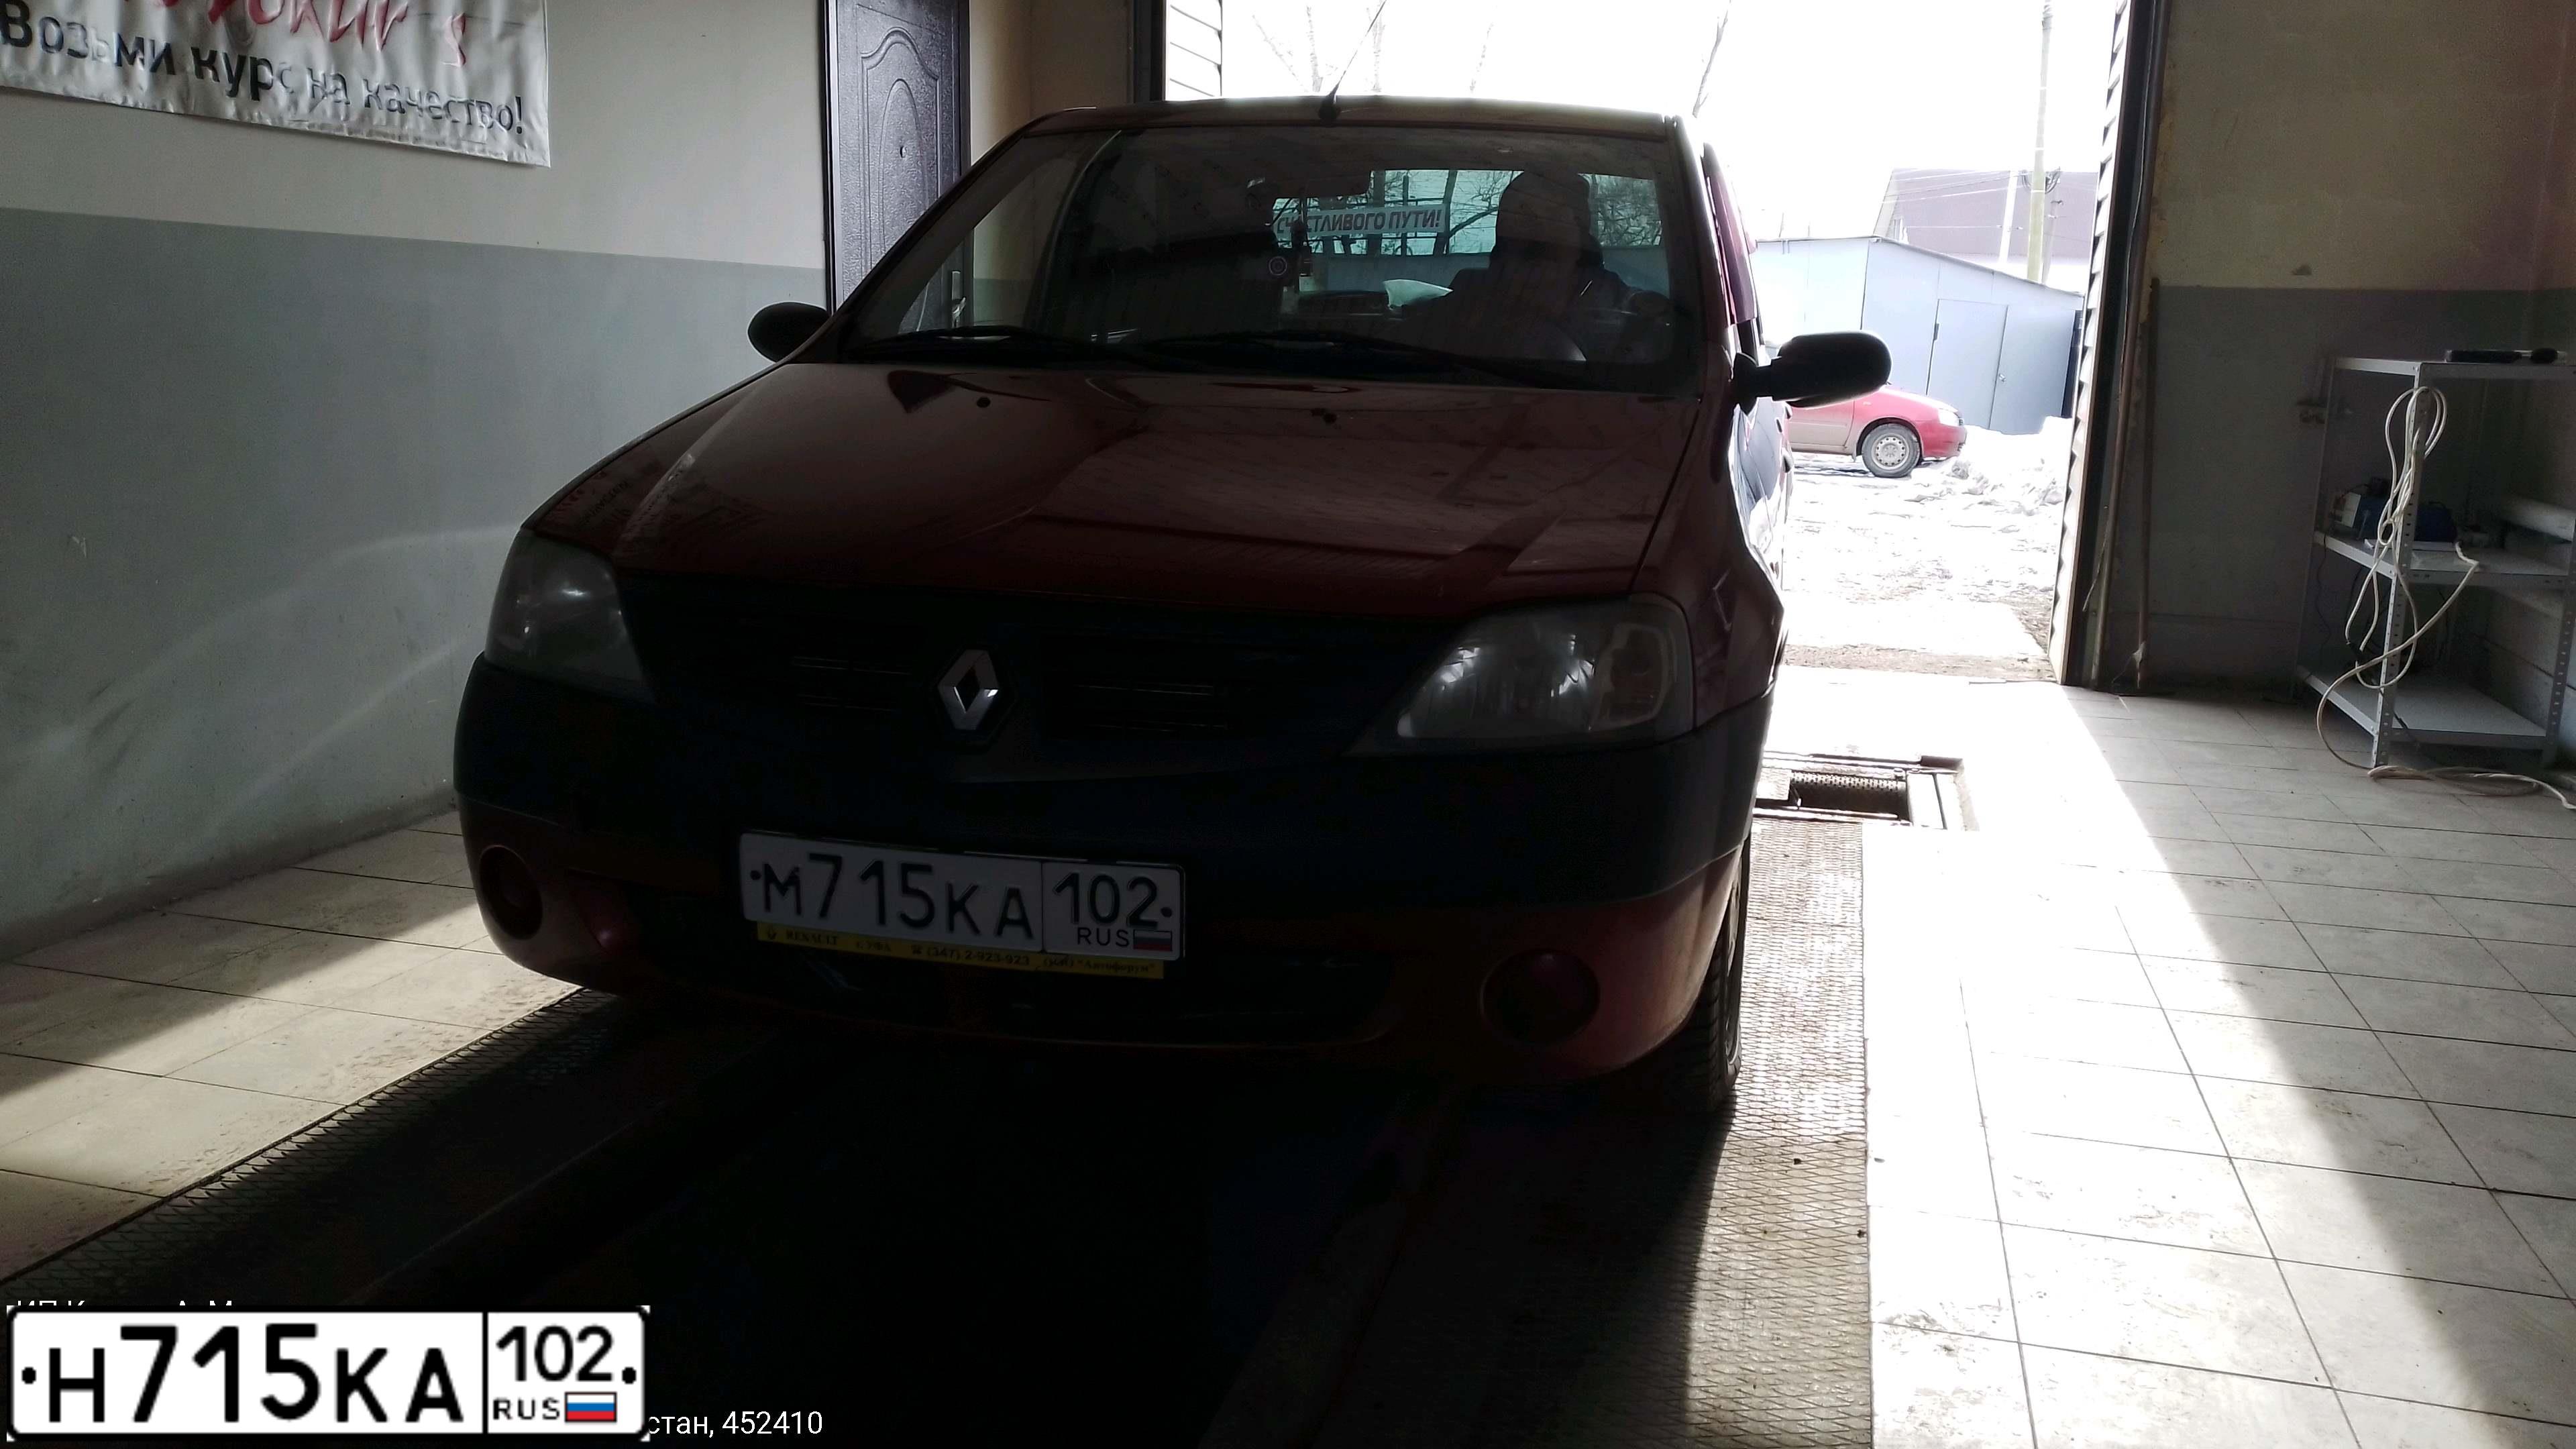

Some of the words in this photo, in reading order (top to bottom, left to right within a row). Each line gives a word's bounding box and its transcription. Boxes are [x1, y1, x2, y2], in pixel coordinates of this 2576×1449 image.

[0, 0, 176, 76] Возьми
[191, 46, 295, 103] курс
[307, 66, 351, 106] на
[362, 78, 523, 135] качество!
[1277, 211, 1387, 234] СЧСТЛИВОГО
[1389, 209, 1442, 232] ПУТИ!
[1054, 872, 1159, 928] 102
[1076, 926, 1130, 947] RUS
